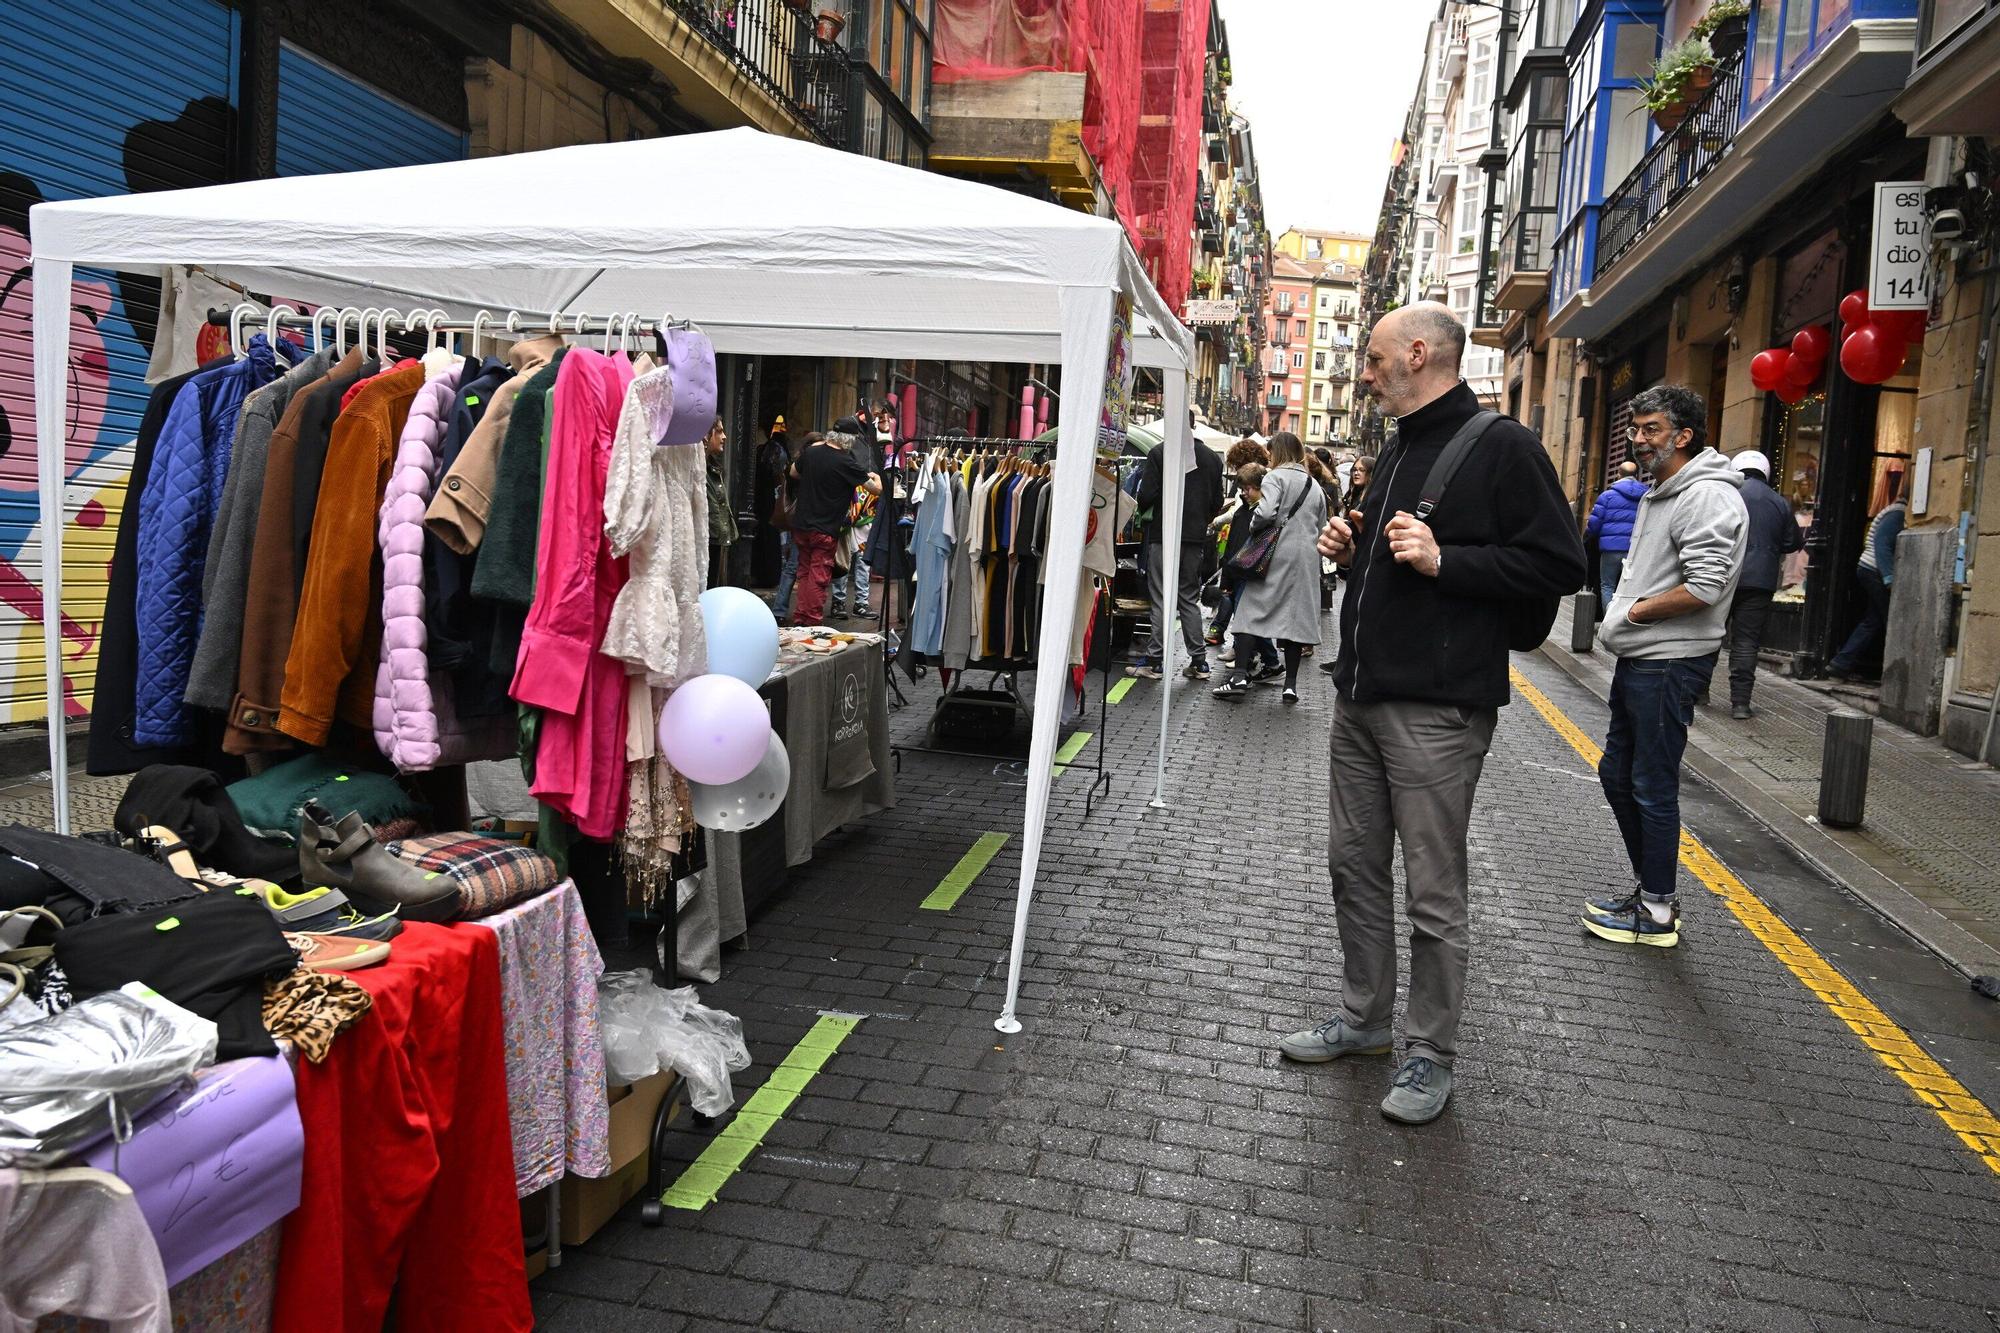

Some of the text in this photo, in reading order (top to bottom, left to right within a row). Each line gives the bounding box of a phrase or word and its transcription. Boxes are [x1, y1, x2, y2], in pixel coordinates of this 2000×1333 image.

[1895, 192, 1920, 208] es
[1894, 217, 1920, 236] tu
[1887, 245, 1921, 264] dio
[1887, 278, 1915, 299] 14
[162, 1132, 249, 1234] 2 €
